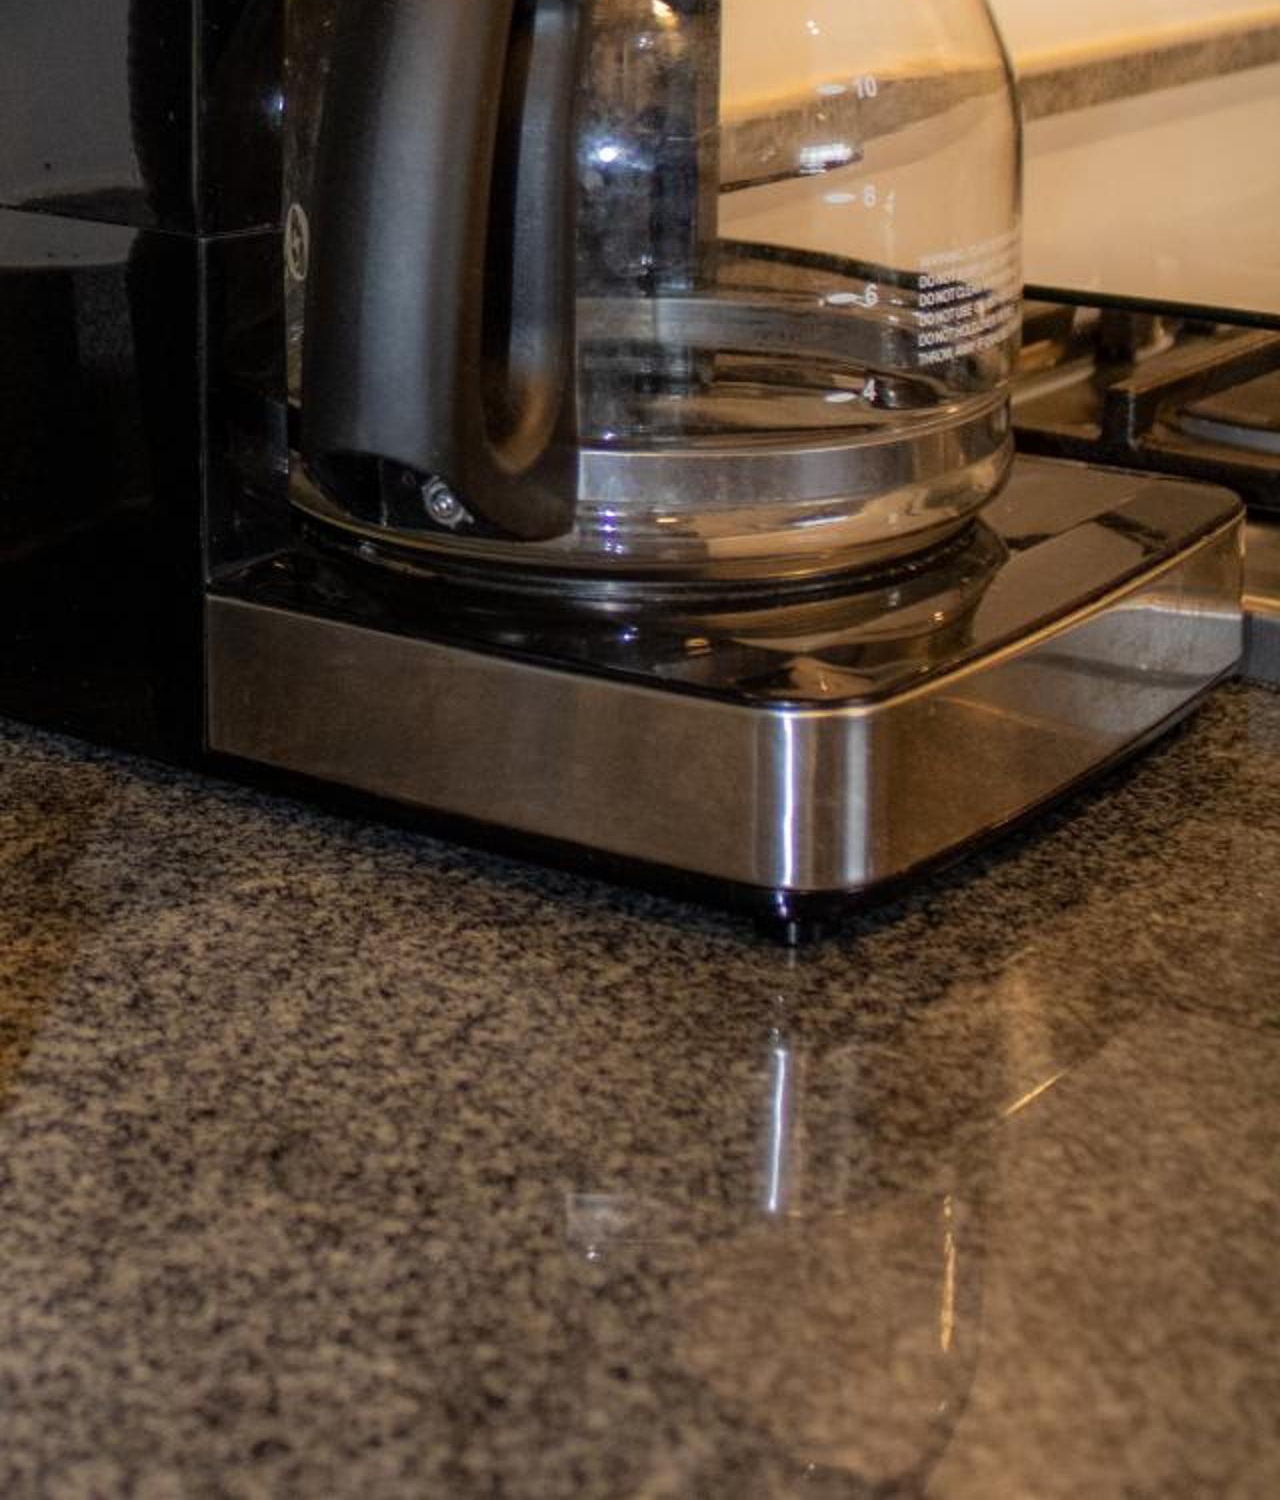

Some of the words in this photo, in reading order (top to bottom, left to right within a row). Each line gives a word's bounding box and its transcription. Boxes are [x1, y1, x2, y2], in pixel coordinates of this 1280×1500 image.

[854, 76, 878, 100] 10
[864, 282, 879, 308] 6
[919, 293, 935, 307] DO
[936, 288, 955, 303] NOT
[919, 314, 935, 327] DO
[919, 333, 935, 347] DO
[863, 377, 878, 401] 4
